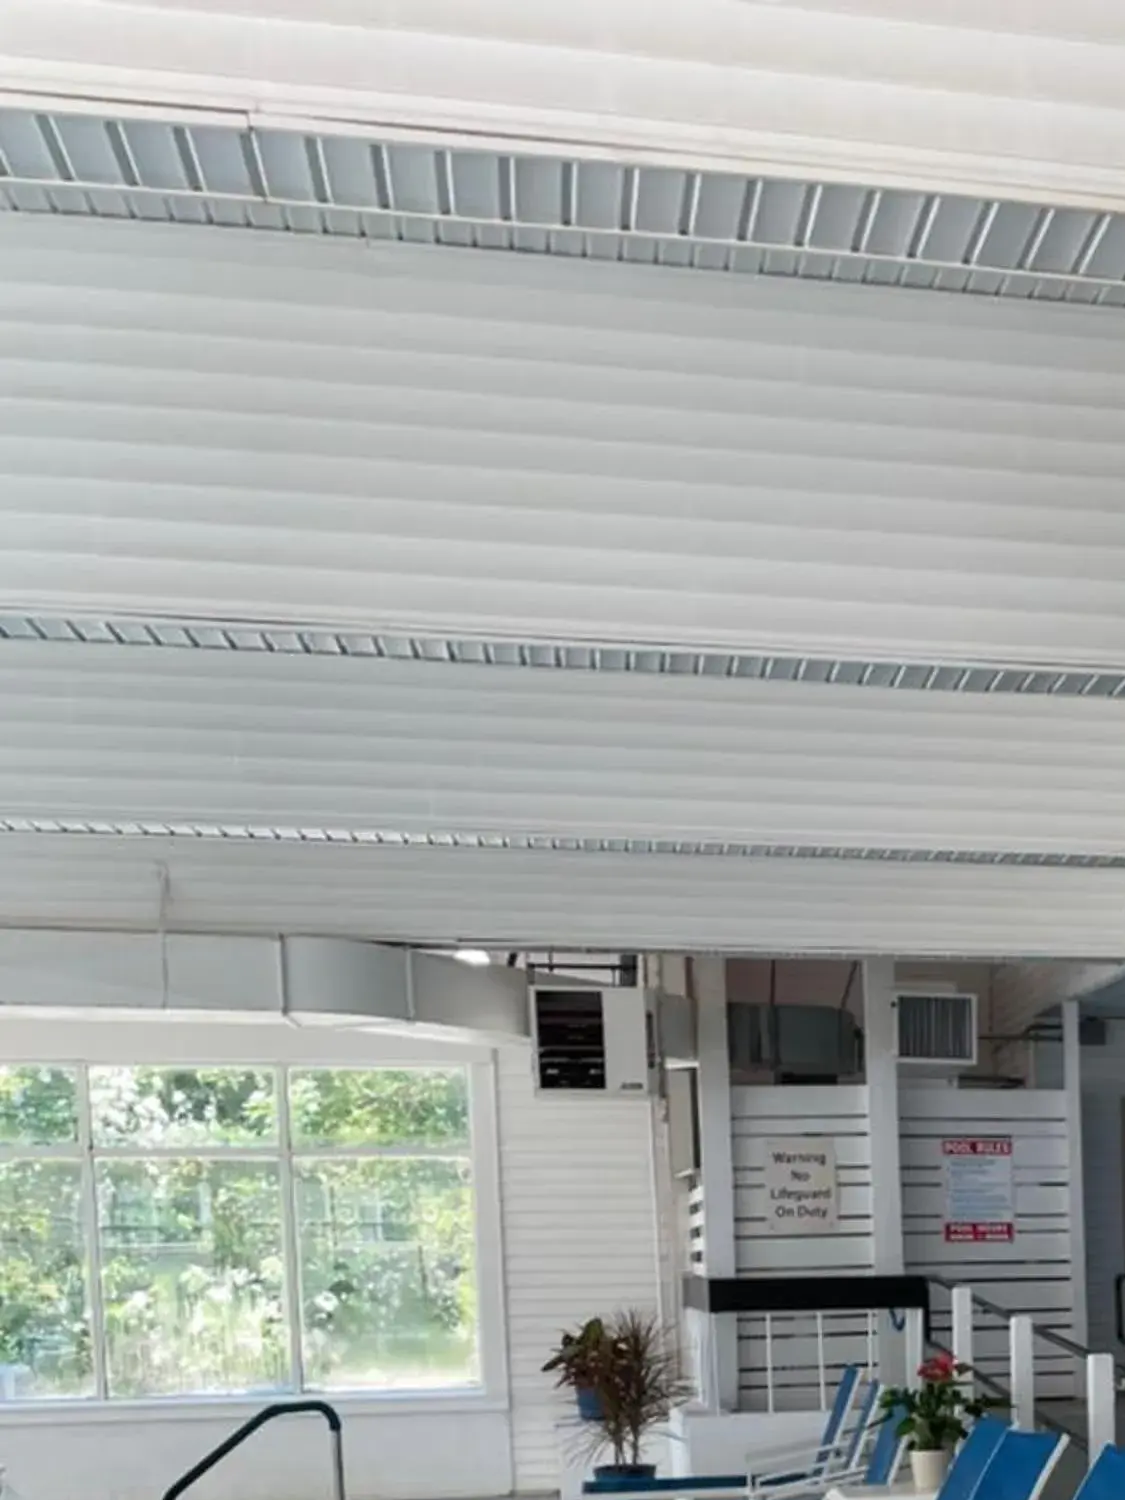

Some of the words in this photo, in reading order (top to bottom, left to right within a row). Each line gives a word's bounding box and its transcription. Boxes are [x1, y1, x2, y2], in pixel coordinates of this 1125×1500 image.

[944, 1141, 973, 1154] POOL
[772, 1152, 826, 1167] Warning
[790, 1169, 811, 1182] No
[769, 1186, 831, 1202] Lifeguard
[774, 1205, 795, 1218] On
[797, 1204, 828, 1219] Duty
